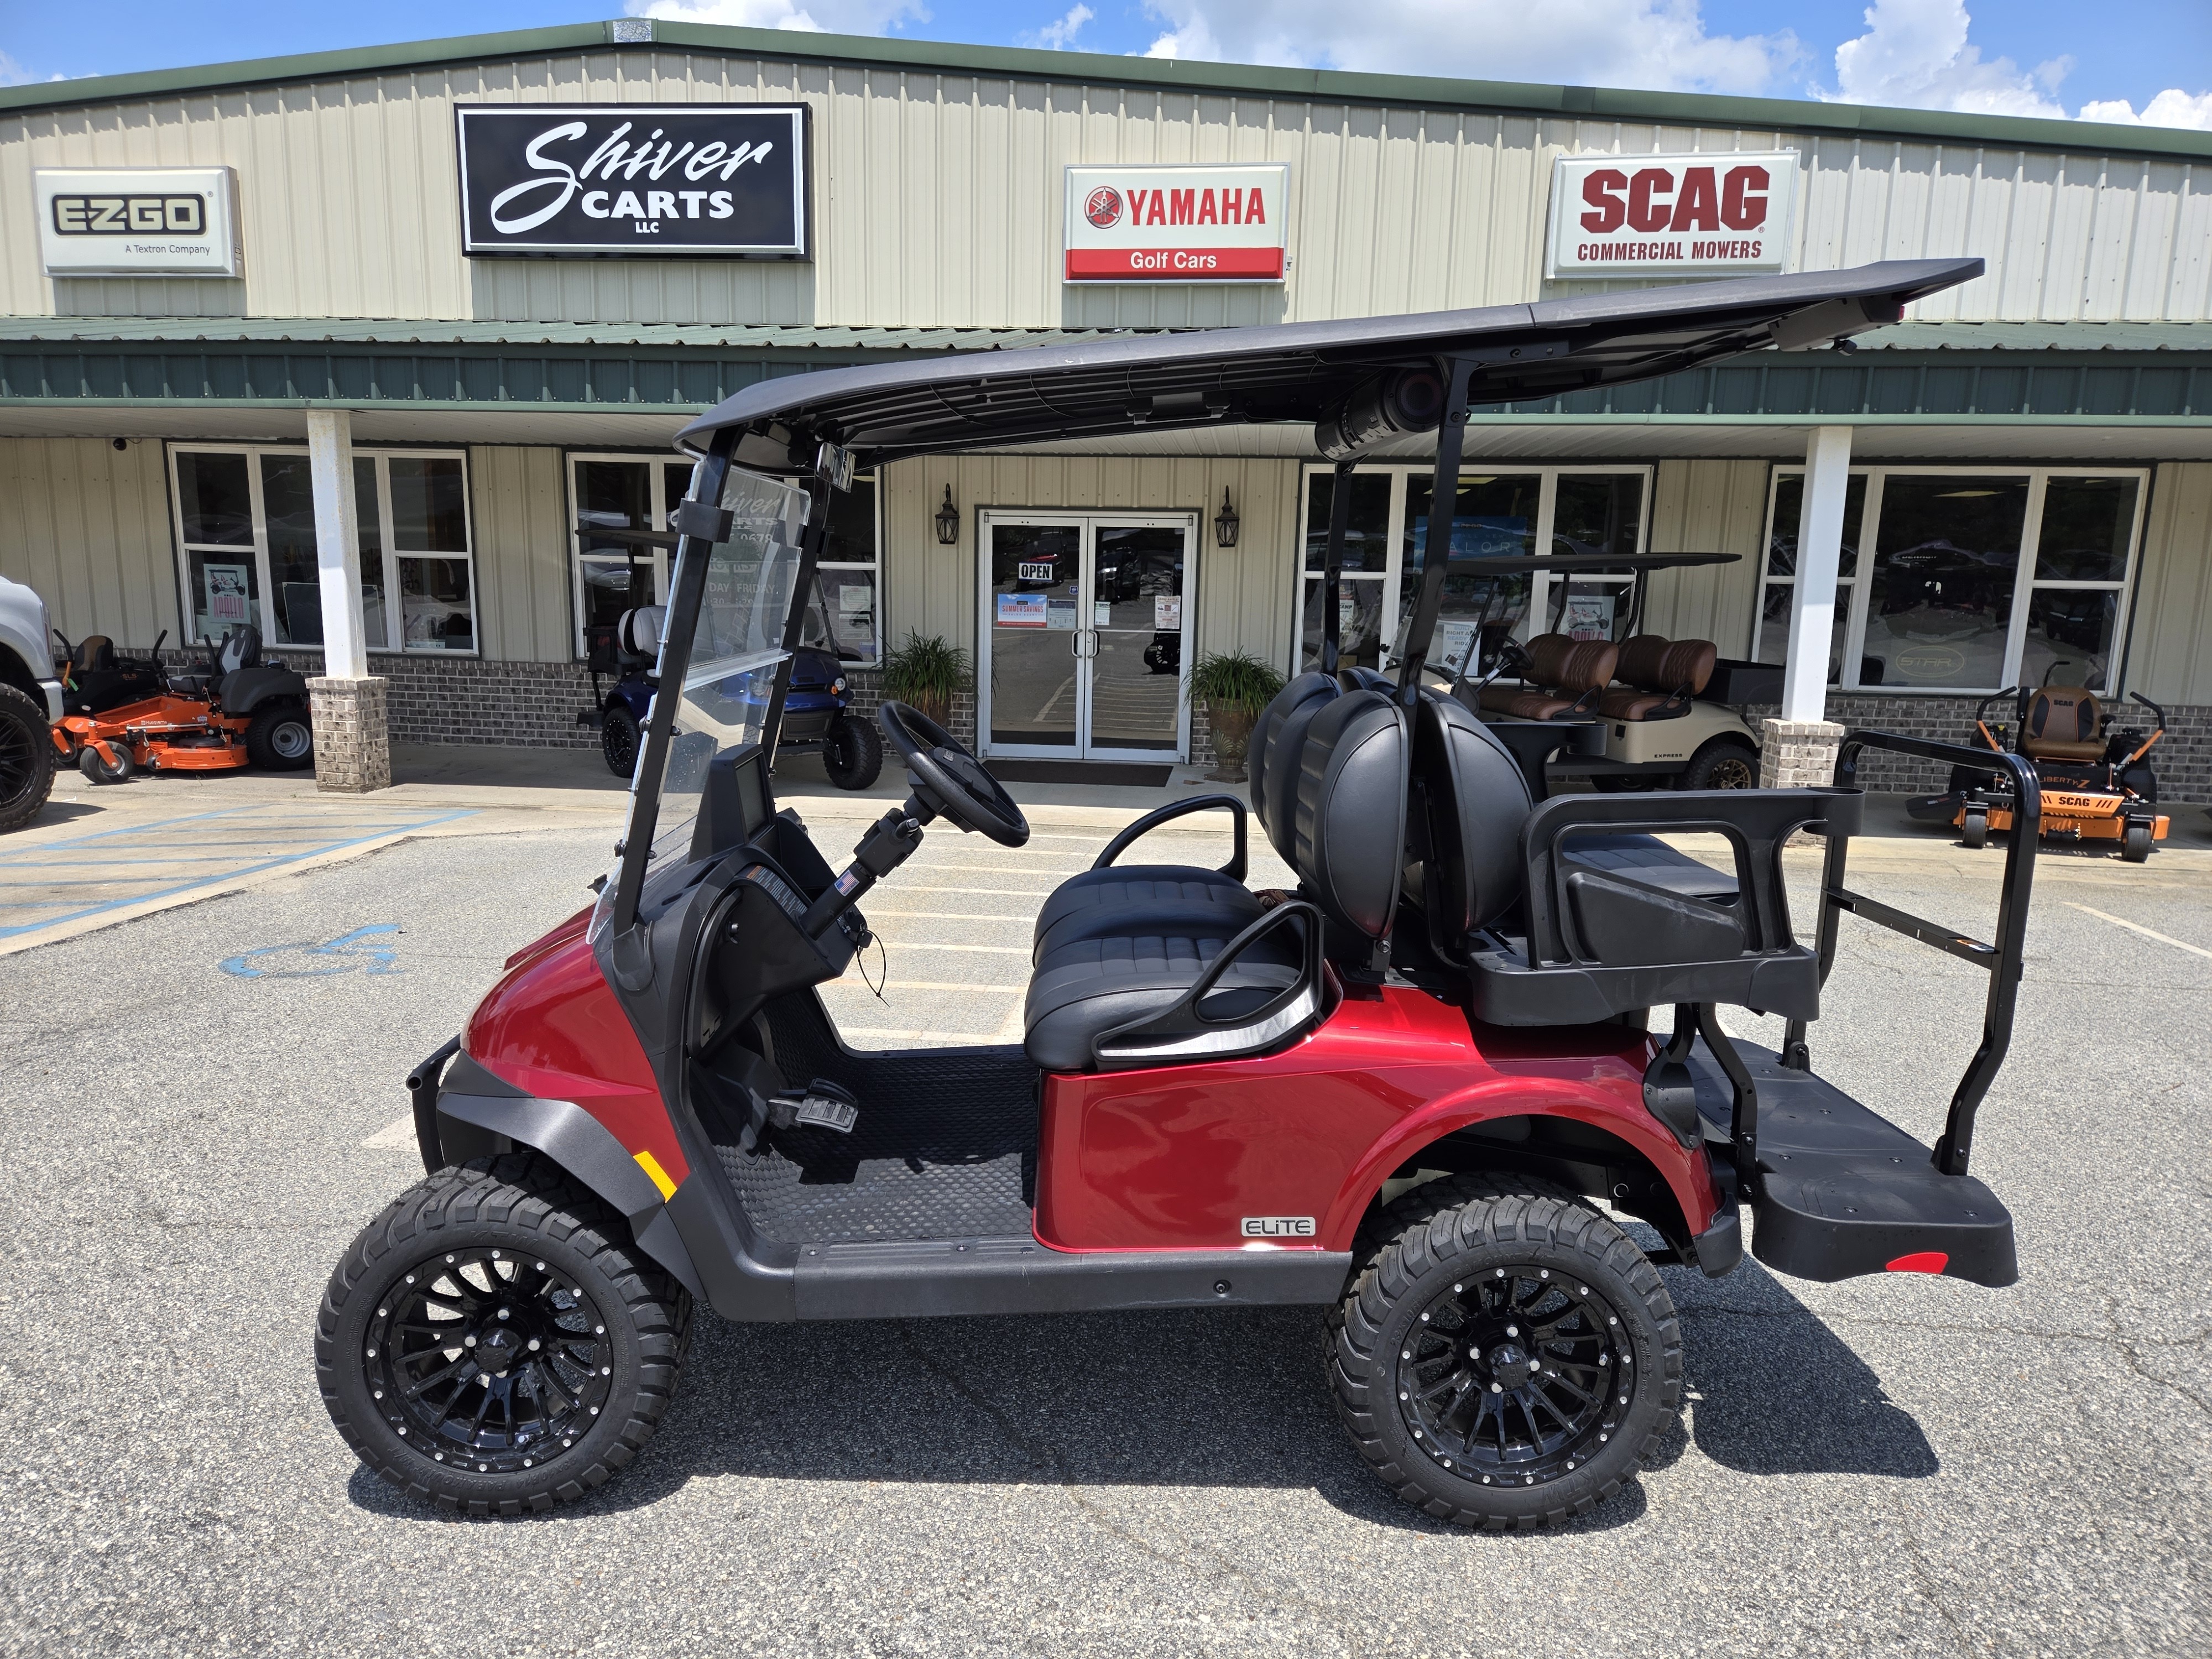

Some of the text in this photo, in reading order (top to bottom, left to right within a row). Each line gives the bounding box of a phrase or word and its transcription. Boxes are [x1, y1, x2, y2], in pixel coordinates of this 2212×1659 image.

[491, 121, 773, 234] Shiver
[581, 191, 734, 218] CARTS
[1126, 187, 1266, 226] YAMAHA
[1580, 165, 1770, 233] SCAG
[636, 222, 659, 233] LLC
[126, 244, 210, 255] A Textron Company
[1578, 240, 1762, 262] COMMERCIAL MOWERS
[1130, 252, 1217, 269] Golf Cars
[721, 489, 780, 513] hiver
[732, 517, 778, 525] ARTS
[1450, 542, 1510, 552] ALOR
[1021, 565, 1050, 578] OPEN
[213, 597, 244, 618] APOLLO
[1900, 657, 1952, 667] STAR
[2059, 796, 2090, 807] SCAG
